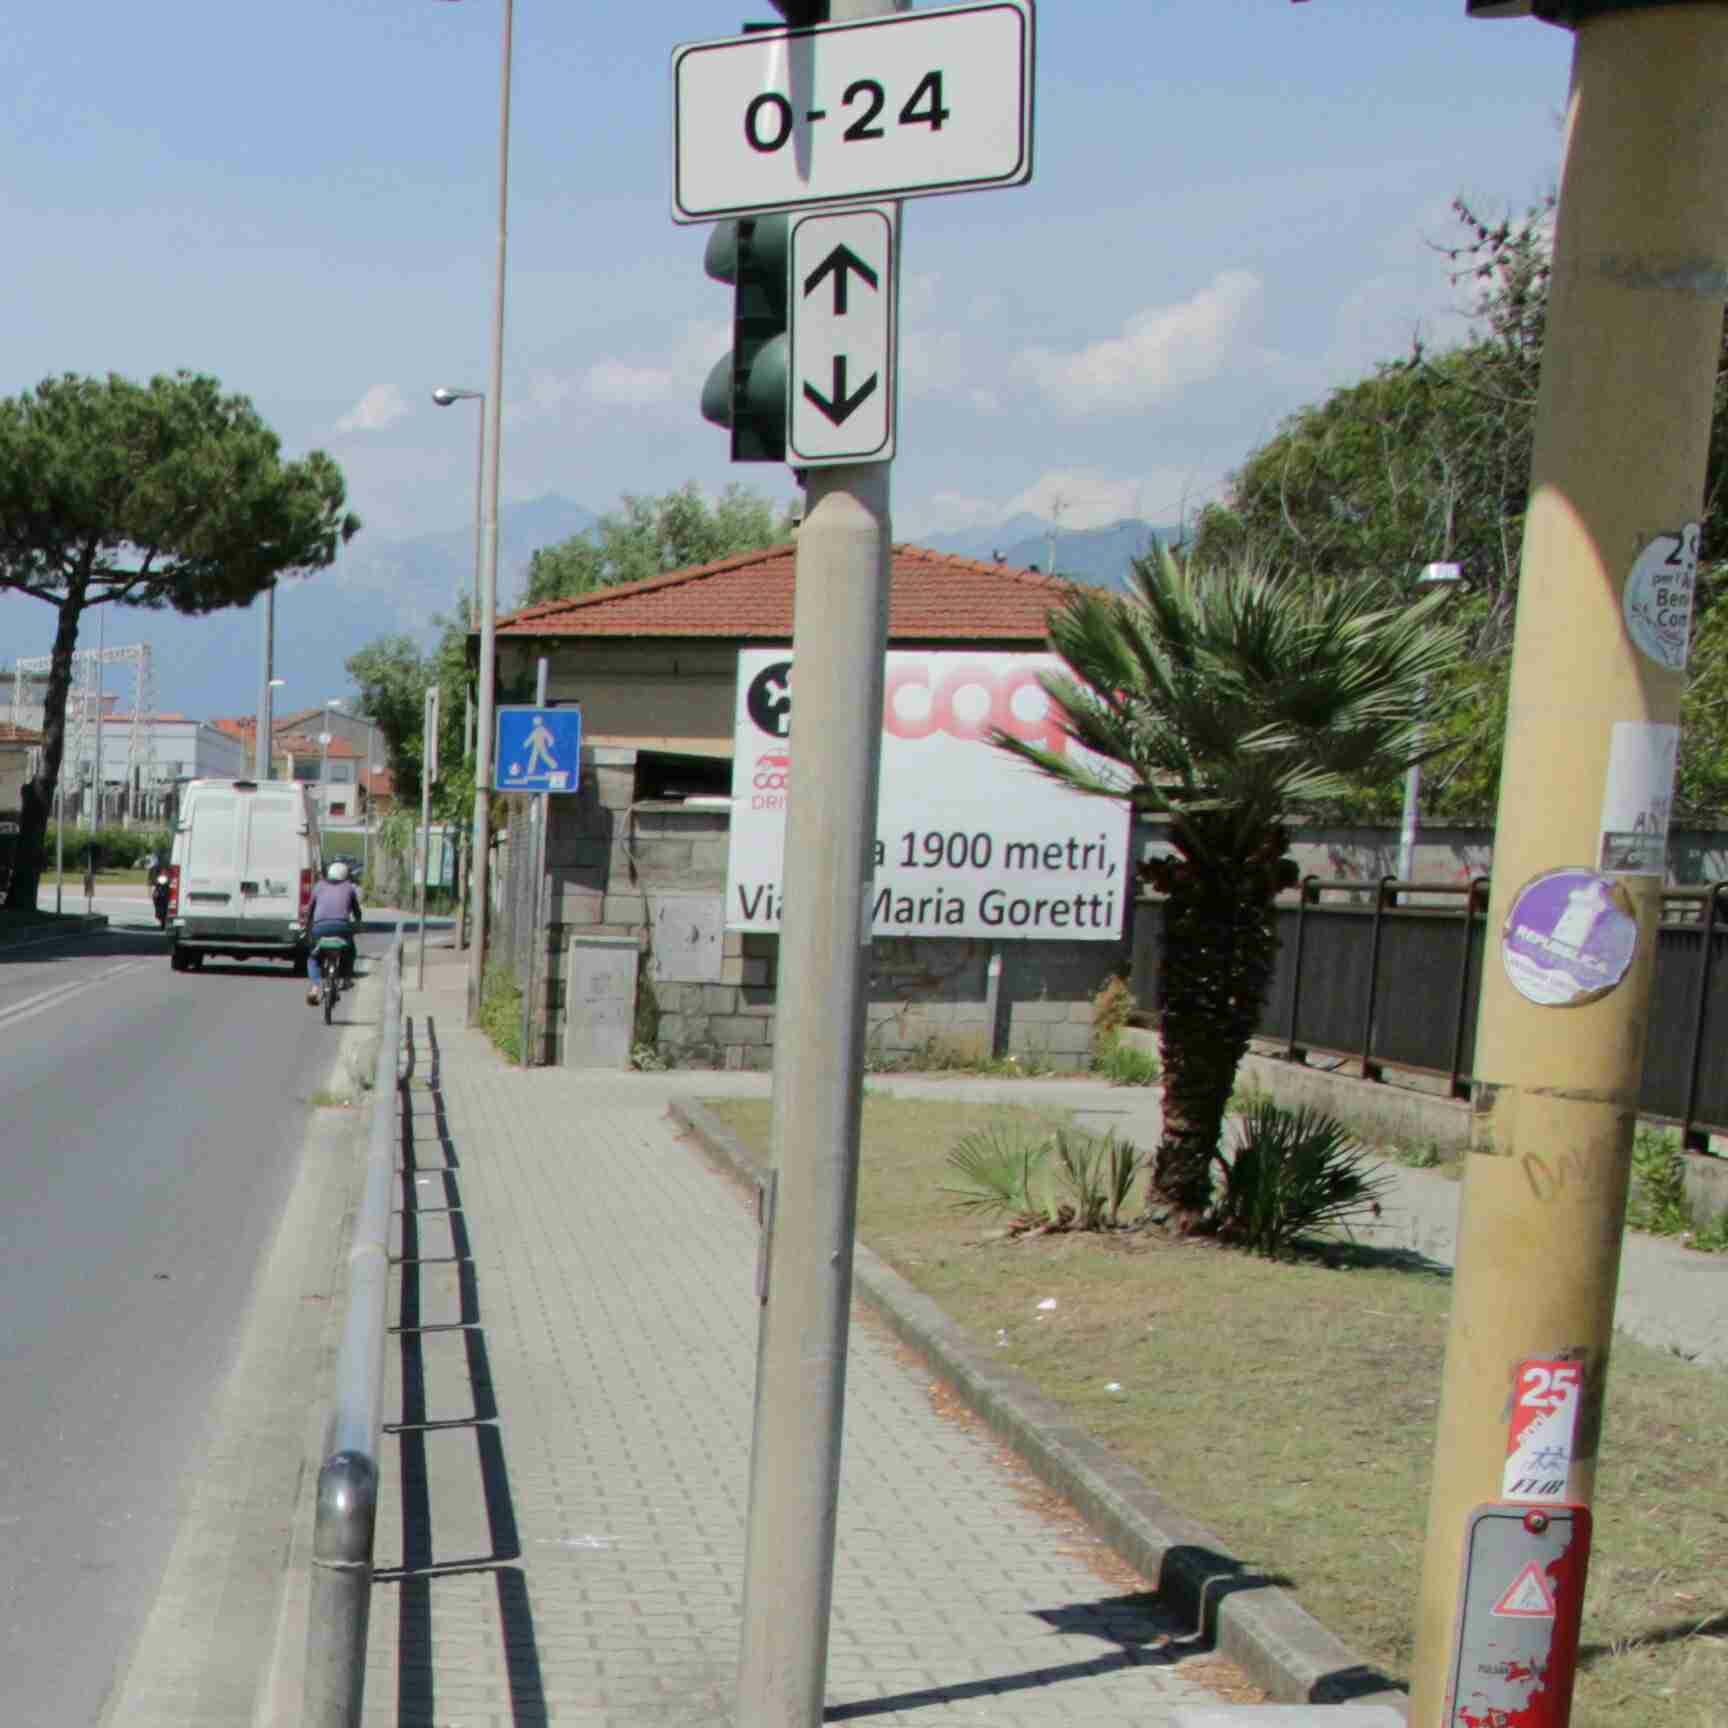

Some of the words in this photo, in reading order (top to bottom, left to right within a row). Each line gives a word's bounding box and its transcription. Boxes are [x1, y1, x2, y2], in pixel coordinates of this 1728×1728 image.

[745, 70, 949, 153] 0-24
[900, 832, 991, 868] 1900
[1004, 834, 1116, 876] metri,
[979, 890, 1114, 928] Goretti
[1520, 1367, 1578, 1408] 25
